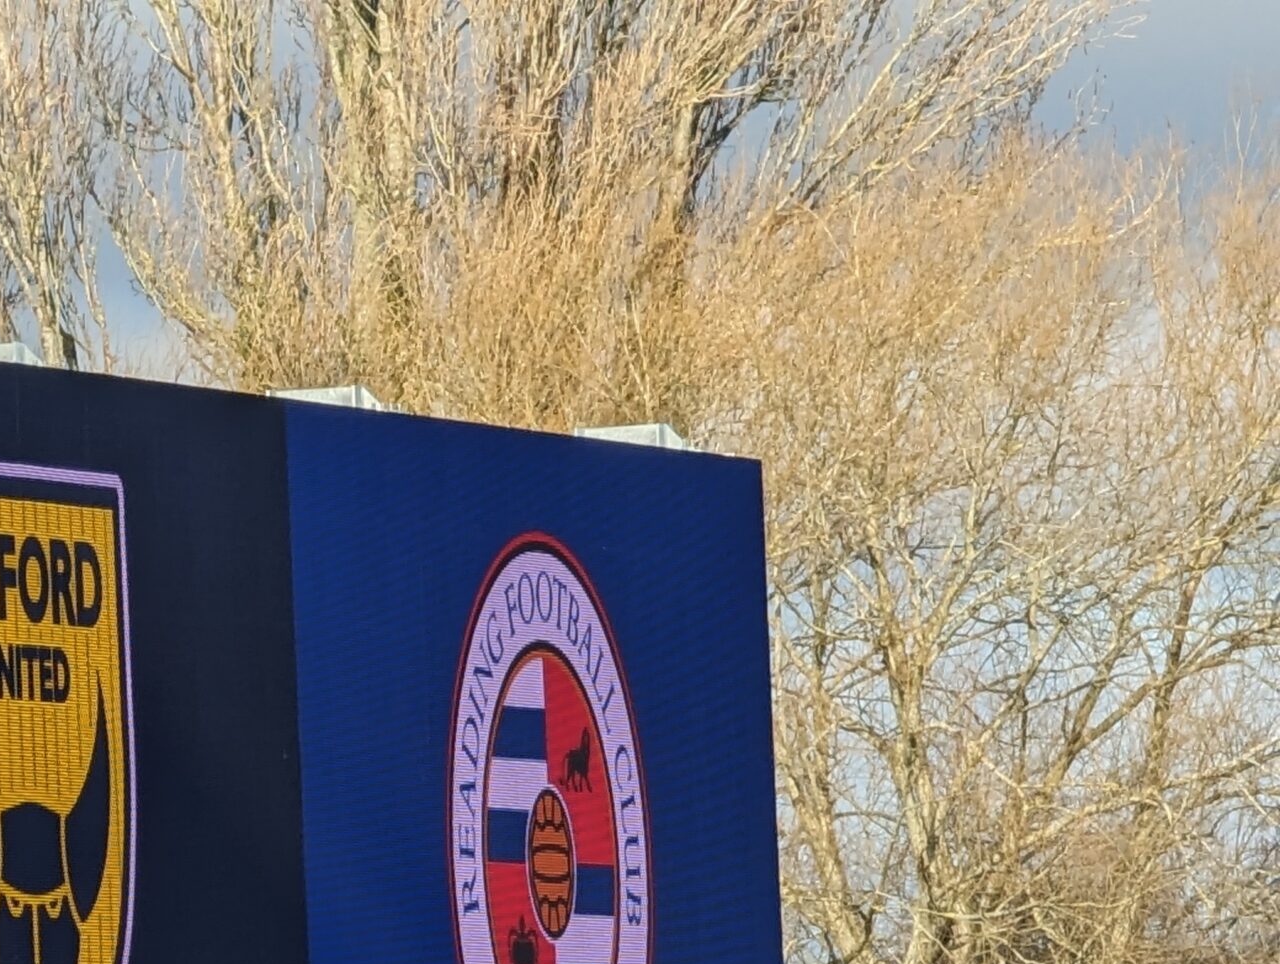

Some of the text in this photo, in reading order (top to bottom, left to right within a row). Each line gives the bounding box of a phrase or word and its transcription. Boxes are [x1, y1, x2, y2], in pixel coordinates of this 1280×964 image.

[459, 571, 642, 927] READING FOOTBALL CLUB
